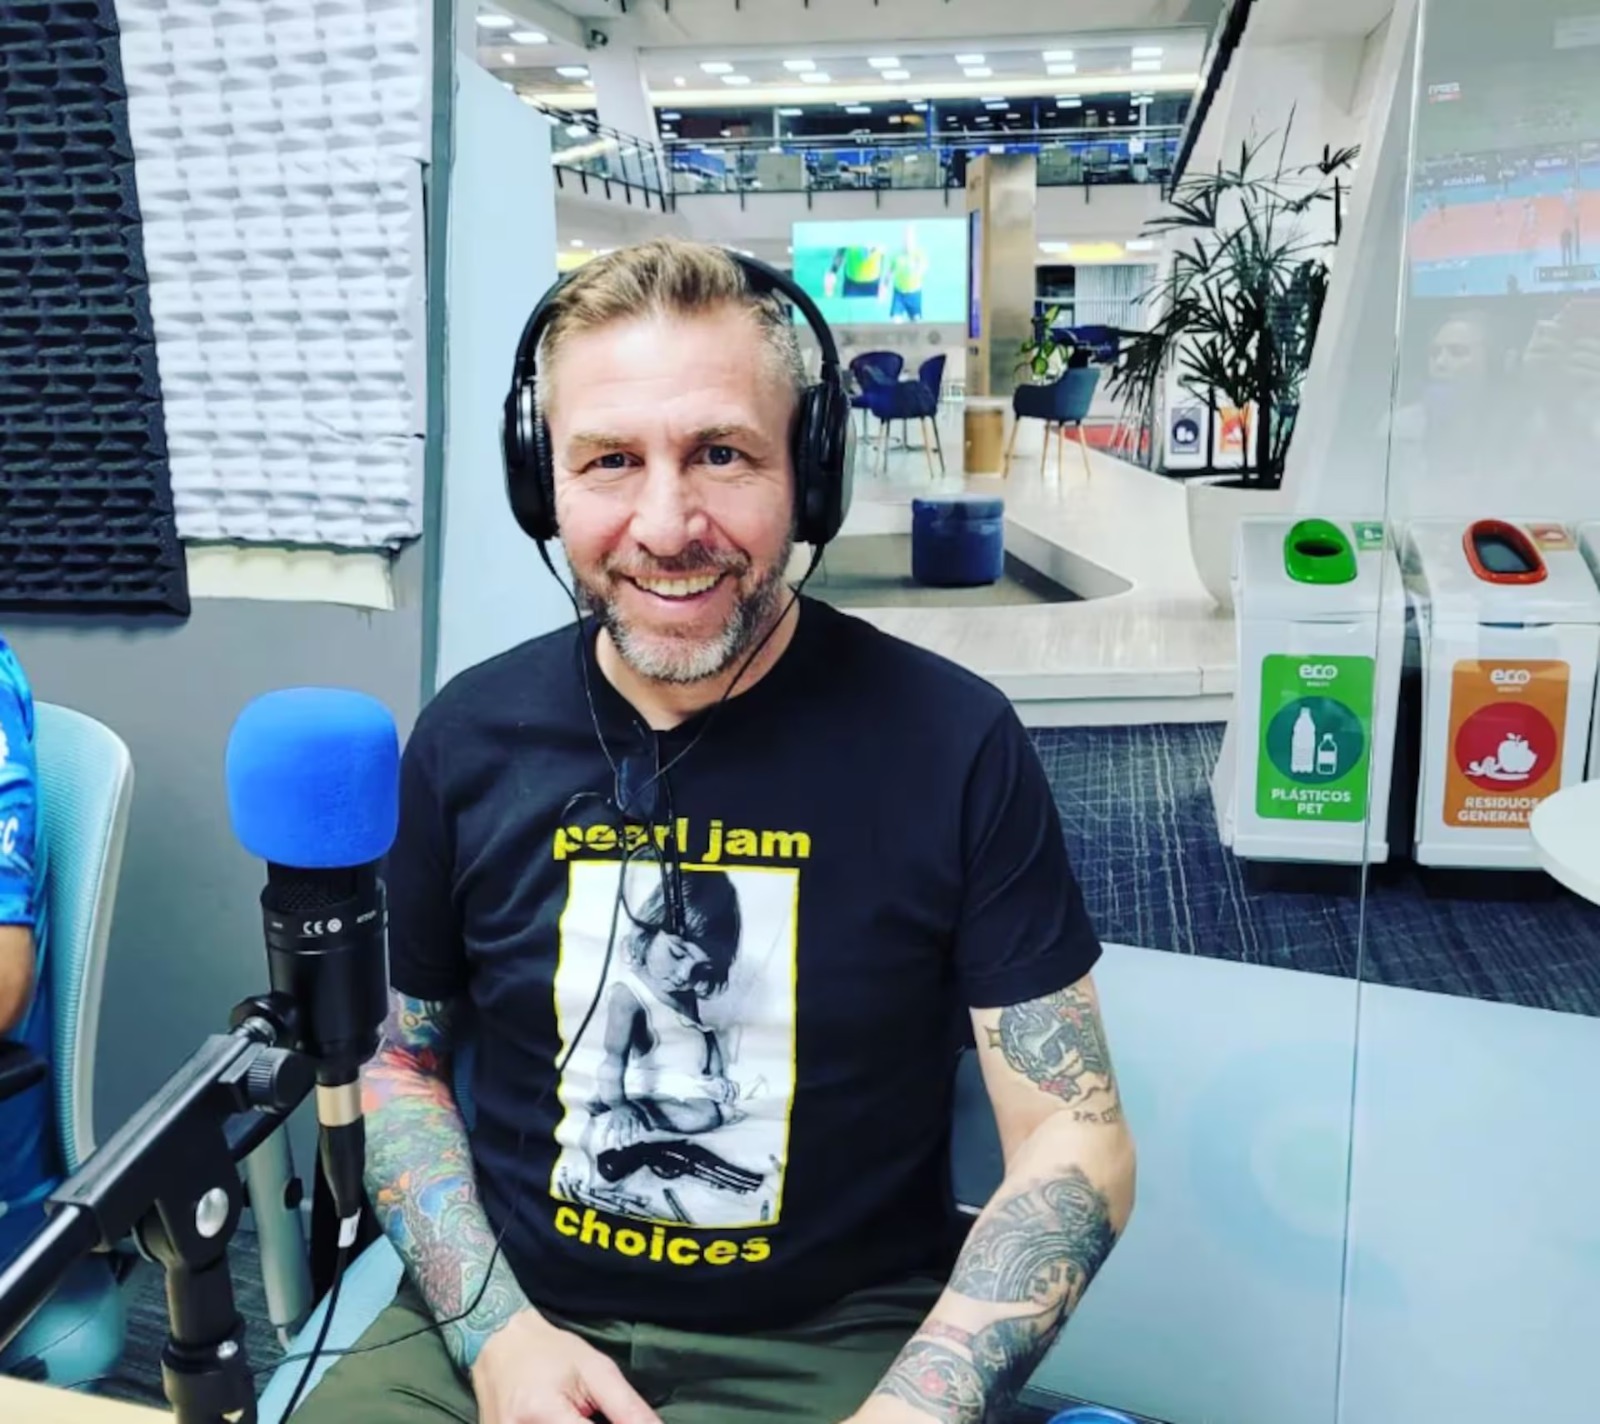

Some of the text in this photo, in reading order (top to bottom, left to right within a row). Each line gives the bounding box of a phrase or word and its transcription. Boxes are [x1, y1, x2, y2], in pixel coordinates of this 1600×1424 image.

[1271, 787, 1351, 803] PLÁSTICOS
[1297, 802, 1324, 816] PET
[553, 817, 812, 863] pearl jam
[553, 1204, 771, 1266] choices
